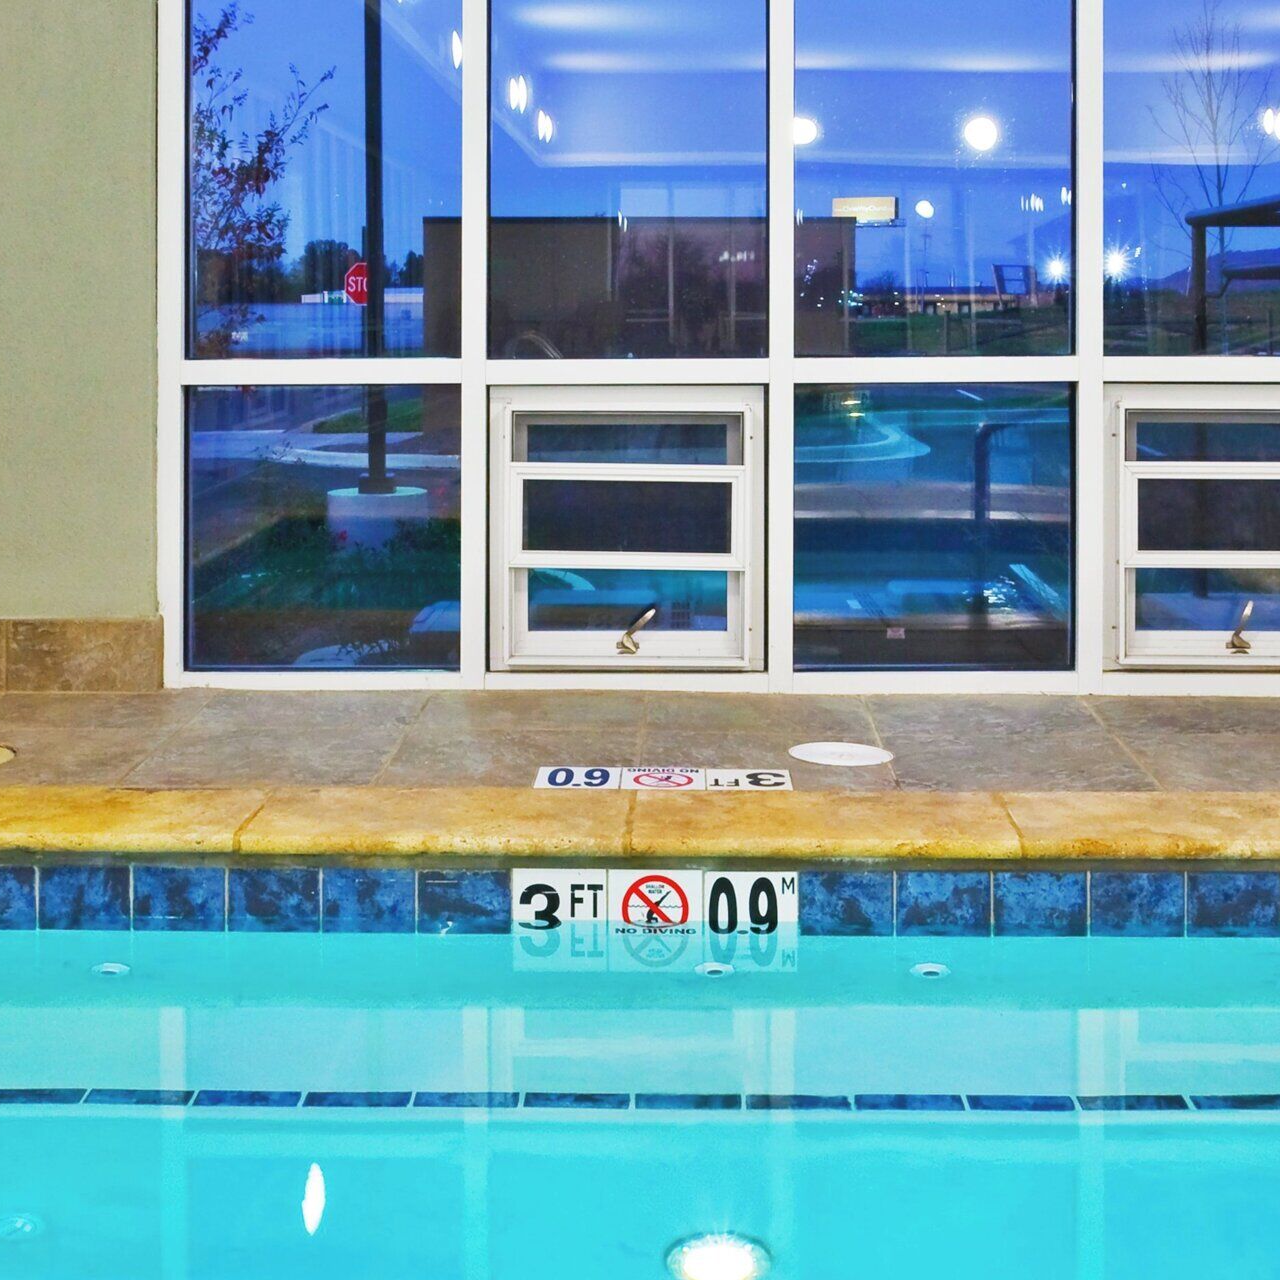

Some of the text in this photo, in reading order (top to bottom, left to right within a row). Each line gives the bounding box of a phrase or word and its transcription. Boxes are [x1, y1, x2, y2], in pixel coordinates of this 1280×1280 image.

[347, 276, 368, 293] ST
[547, 767, 611, 787] 0.9
[709, 772, 786, 787] 3 FT
[519, 883, 604, 930] 3 FT
[708, 876, 796, 935] 0.9 M
[641, 927, 697, 935] DIVING
